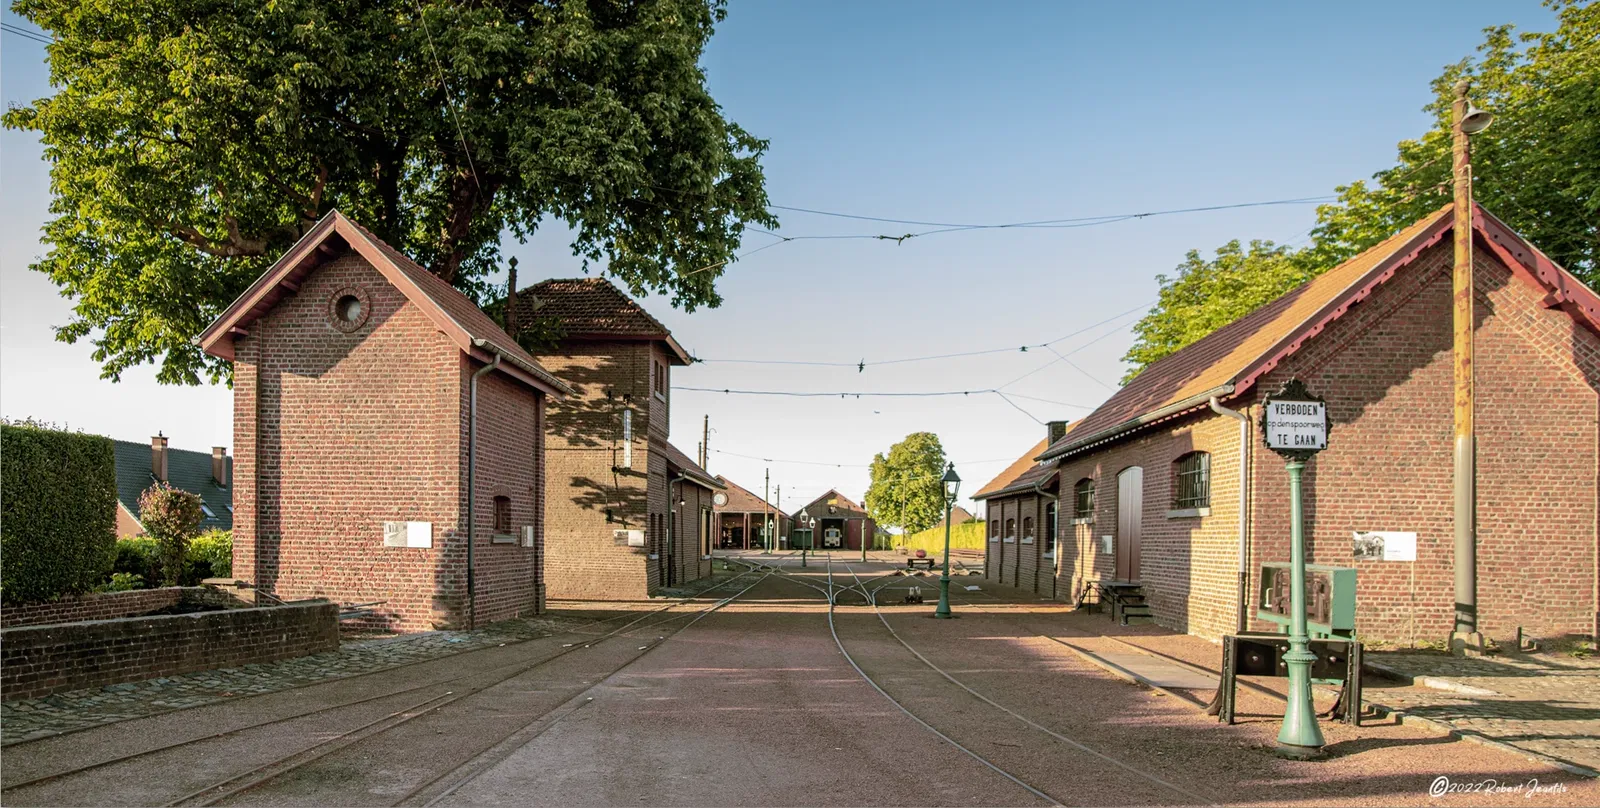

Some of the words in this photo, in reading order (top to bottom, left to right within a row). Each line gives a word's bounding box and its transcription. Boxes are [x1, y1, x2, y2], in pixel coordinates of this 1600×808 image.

[1275, 404, 1318, 415] VERBODEN
[1277, 434, 1288, 445] TE
[1295, 435, 1316, 445] GAAN
